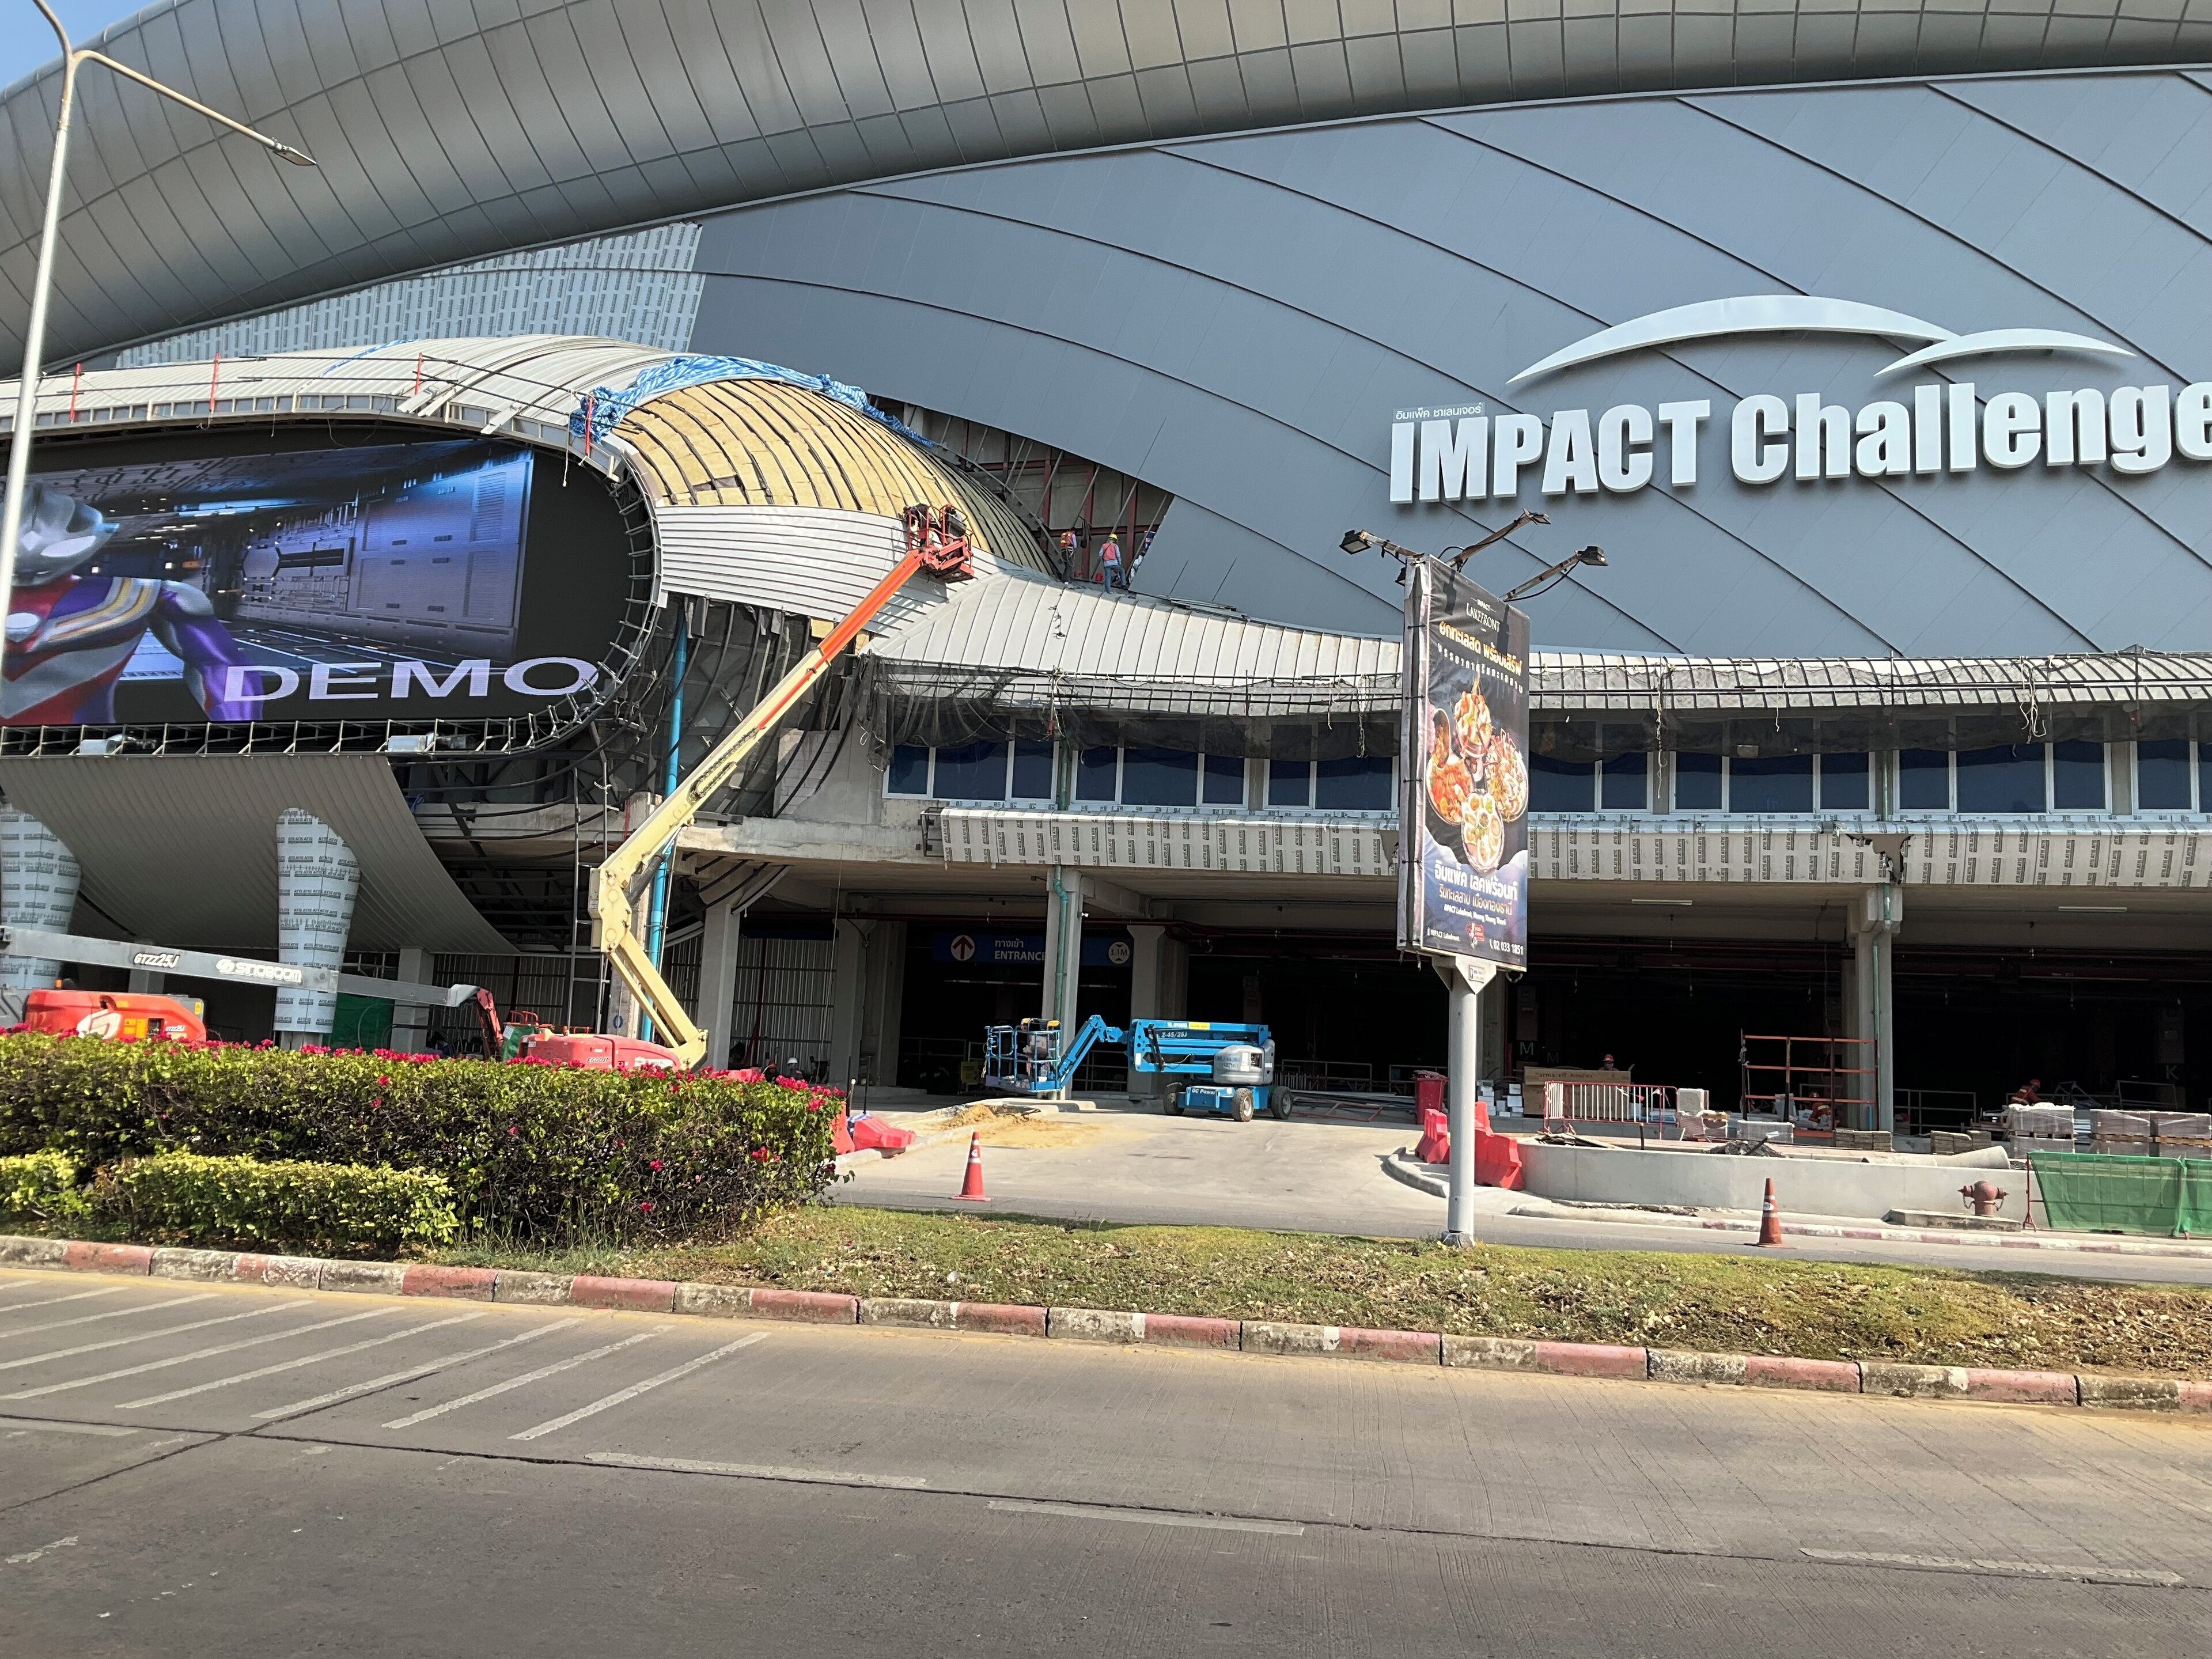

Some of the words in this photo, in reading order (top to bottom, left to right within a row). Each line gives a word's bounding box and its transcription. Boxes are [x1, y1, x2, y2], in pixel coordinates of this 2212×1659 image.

[1395, 407, 1430, 420] อิมแพ็ค
[1433, 402, 1482, 417] ชาเลนเจอร์
[1389, 399, 1710, 505] IMPACT
[1732, 380, 2212, 483] Challenge
[1477, 599, 1490, 611] IMPACT
[1466, 603, 1501, 632] LAKEFRONT
[223, 657, 600, 702] DEMO
[1434, 859, 1467, 888] อิมแพ็ค
[1470, 874, 1518, 901] เลคฟร้อนท์
[1439, 883, 1470, 906] ริมทะเลสาบ
[1472, 892, 1512, 915] เมืองทองธานี
[995, 938, 1024, 948] ทางเข้า
[1493, 939, 1500, 949] 02
[1501, 941, 1510, 952] 033
[1511, 944, 1524, 956] 1851
[134, 953, 180, 968] GTZZ25J
[1520, 1041, 1534, 1055] M
